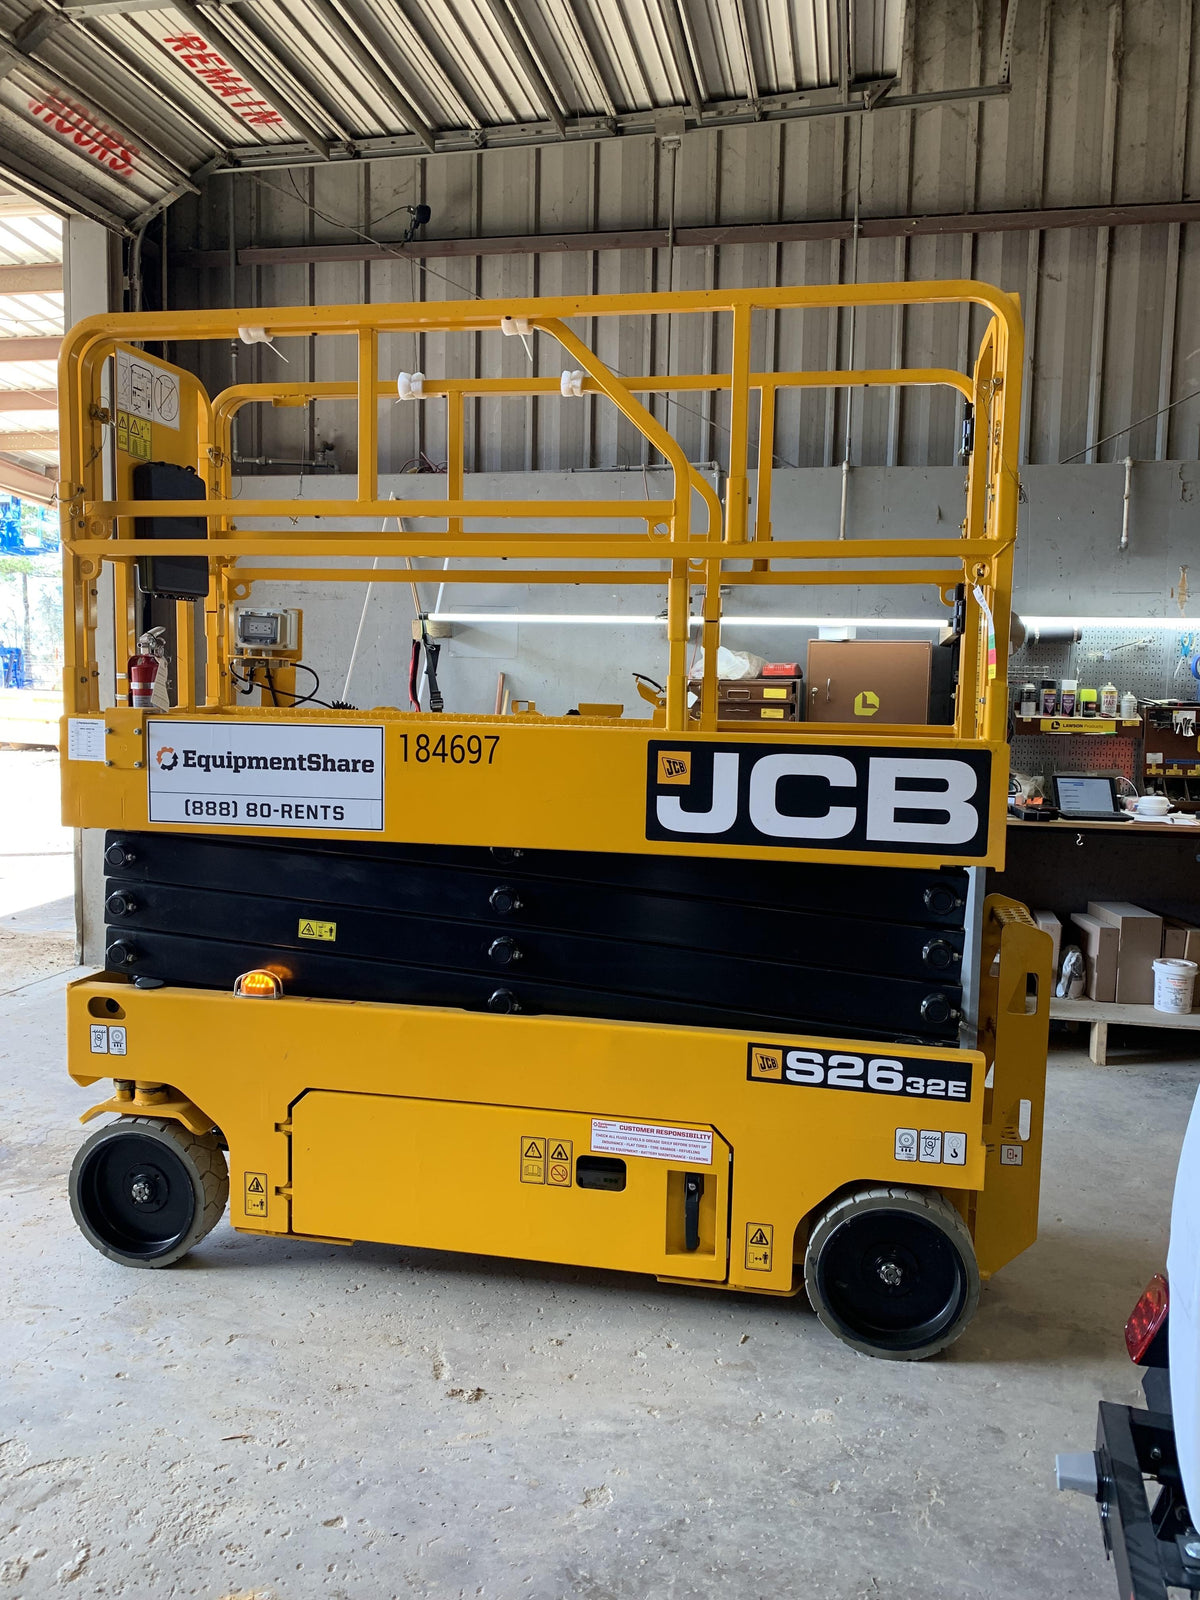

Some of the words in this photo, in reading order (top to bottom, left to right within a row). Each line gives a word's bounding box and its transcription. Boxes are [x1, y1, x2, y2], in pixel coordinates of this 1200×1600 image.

[163, 33, 282, 126] REMAIN
[182, 749, 375, 774] EquipmentShare
[399, 733, 501, 765] 184697
[666, 758, 687, 777] JCB
[184, 798, 238, 818] (888)
[246, 801, 346, 822] 80-RENTS
[656, 752, 979, 845] JCB
[759, 1055, 778, 1069] JCB
[785, 1050, 904, 1092] S26
[619, 1124, 655, 1134] CUSTOMER
[656, 1127, 711, 1140] RESPONSIBILITY
